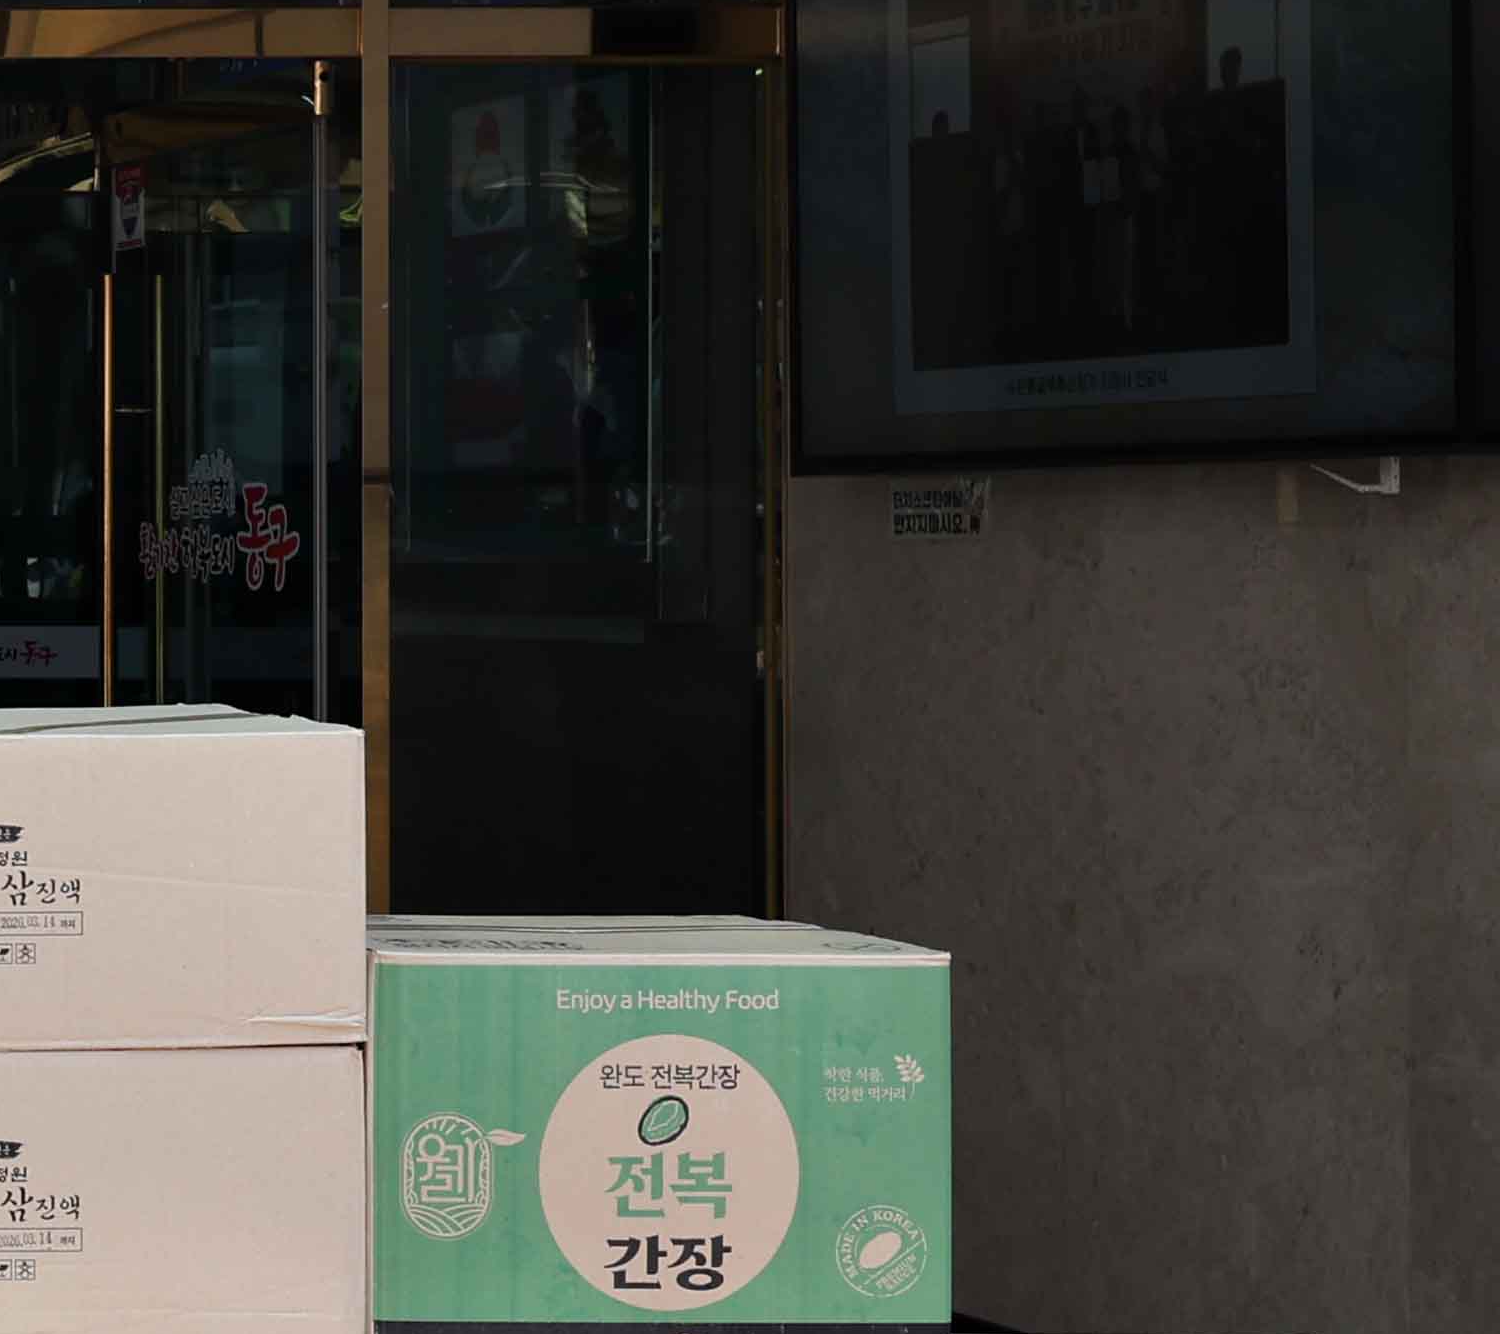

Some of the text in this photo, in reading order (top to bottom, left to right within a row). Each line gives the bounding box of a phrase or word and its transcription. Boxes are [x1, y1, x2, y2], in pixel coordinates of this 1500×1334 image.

[236, 483, 299, 591] 동구
[19, 640, 59, 666] 동구
[604, 1151, 734, 1218] 전복
[604, 1235, 733, 1291] 간장
